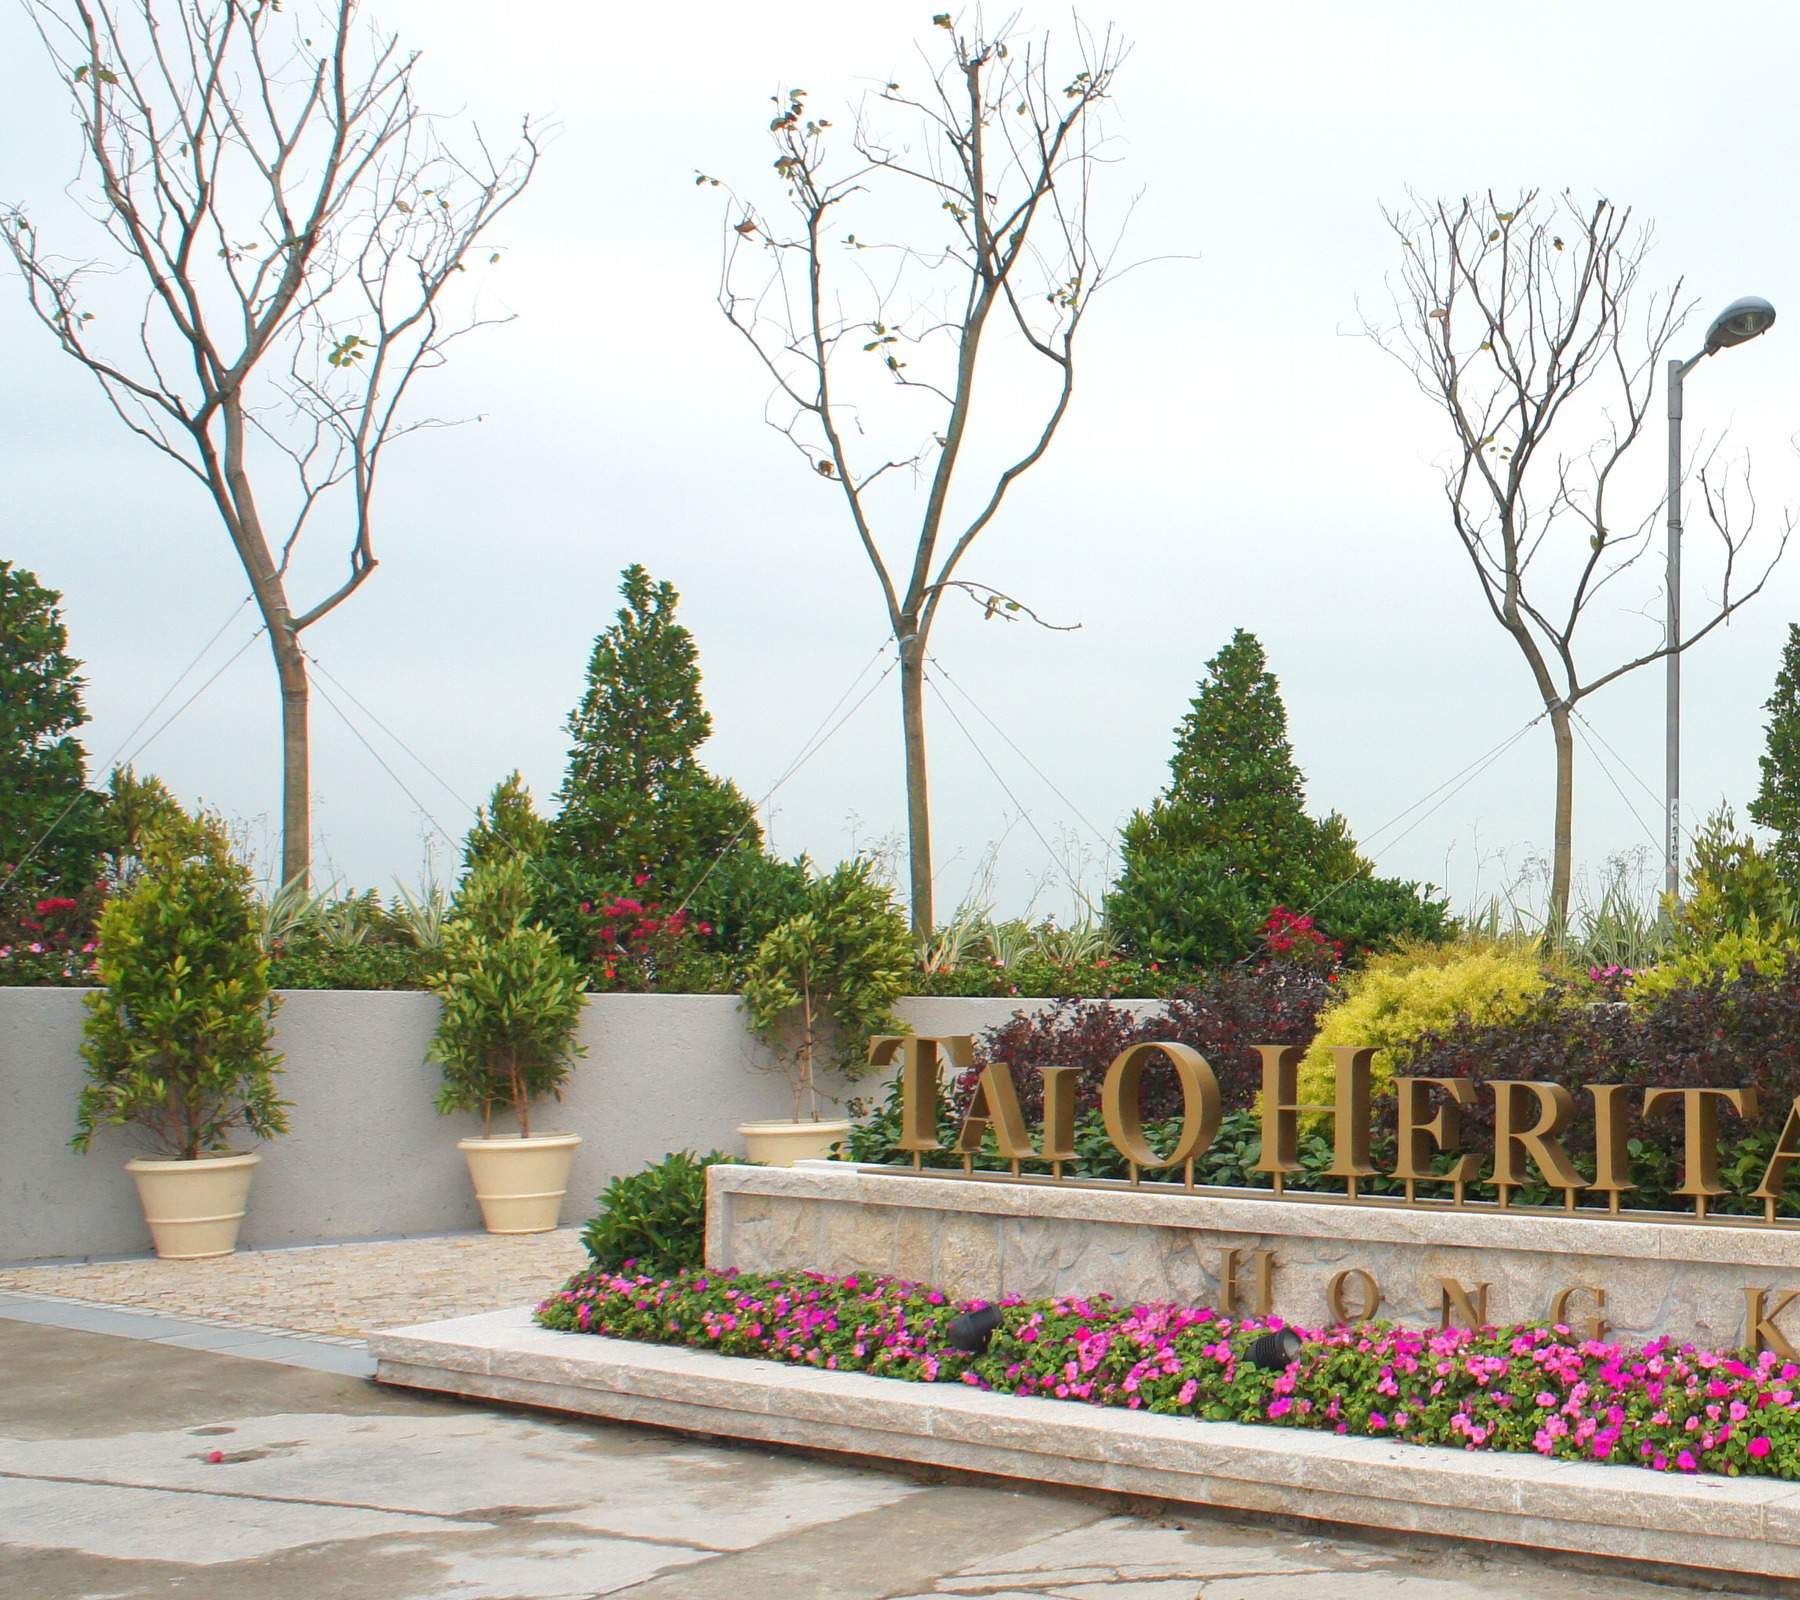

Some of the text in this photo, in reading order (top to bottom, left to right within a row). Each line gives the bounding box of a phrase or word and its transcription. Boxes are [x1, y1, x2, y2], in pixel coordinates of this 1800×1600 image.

[867, 1034, 1083, 1161] TAI
[1102, 1041, 1222, 1168] O
[1218, 1247, 1611, 1342] HONG
